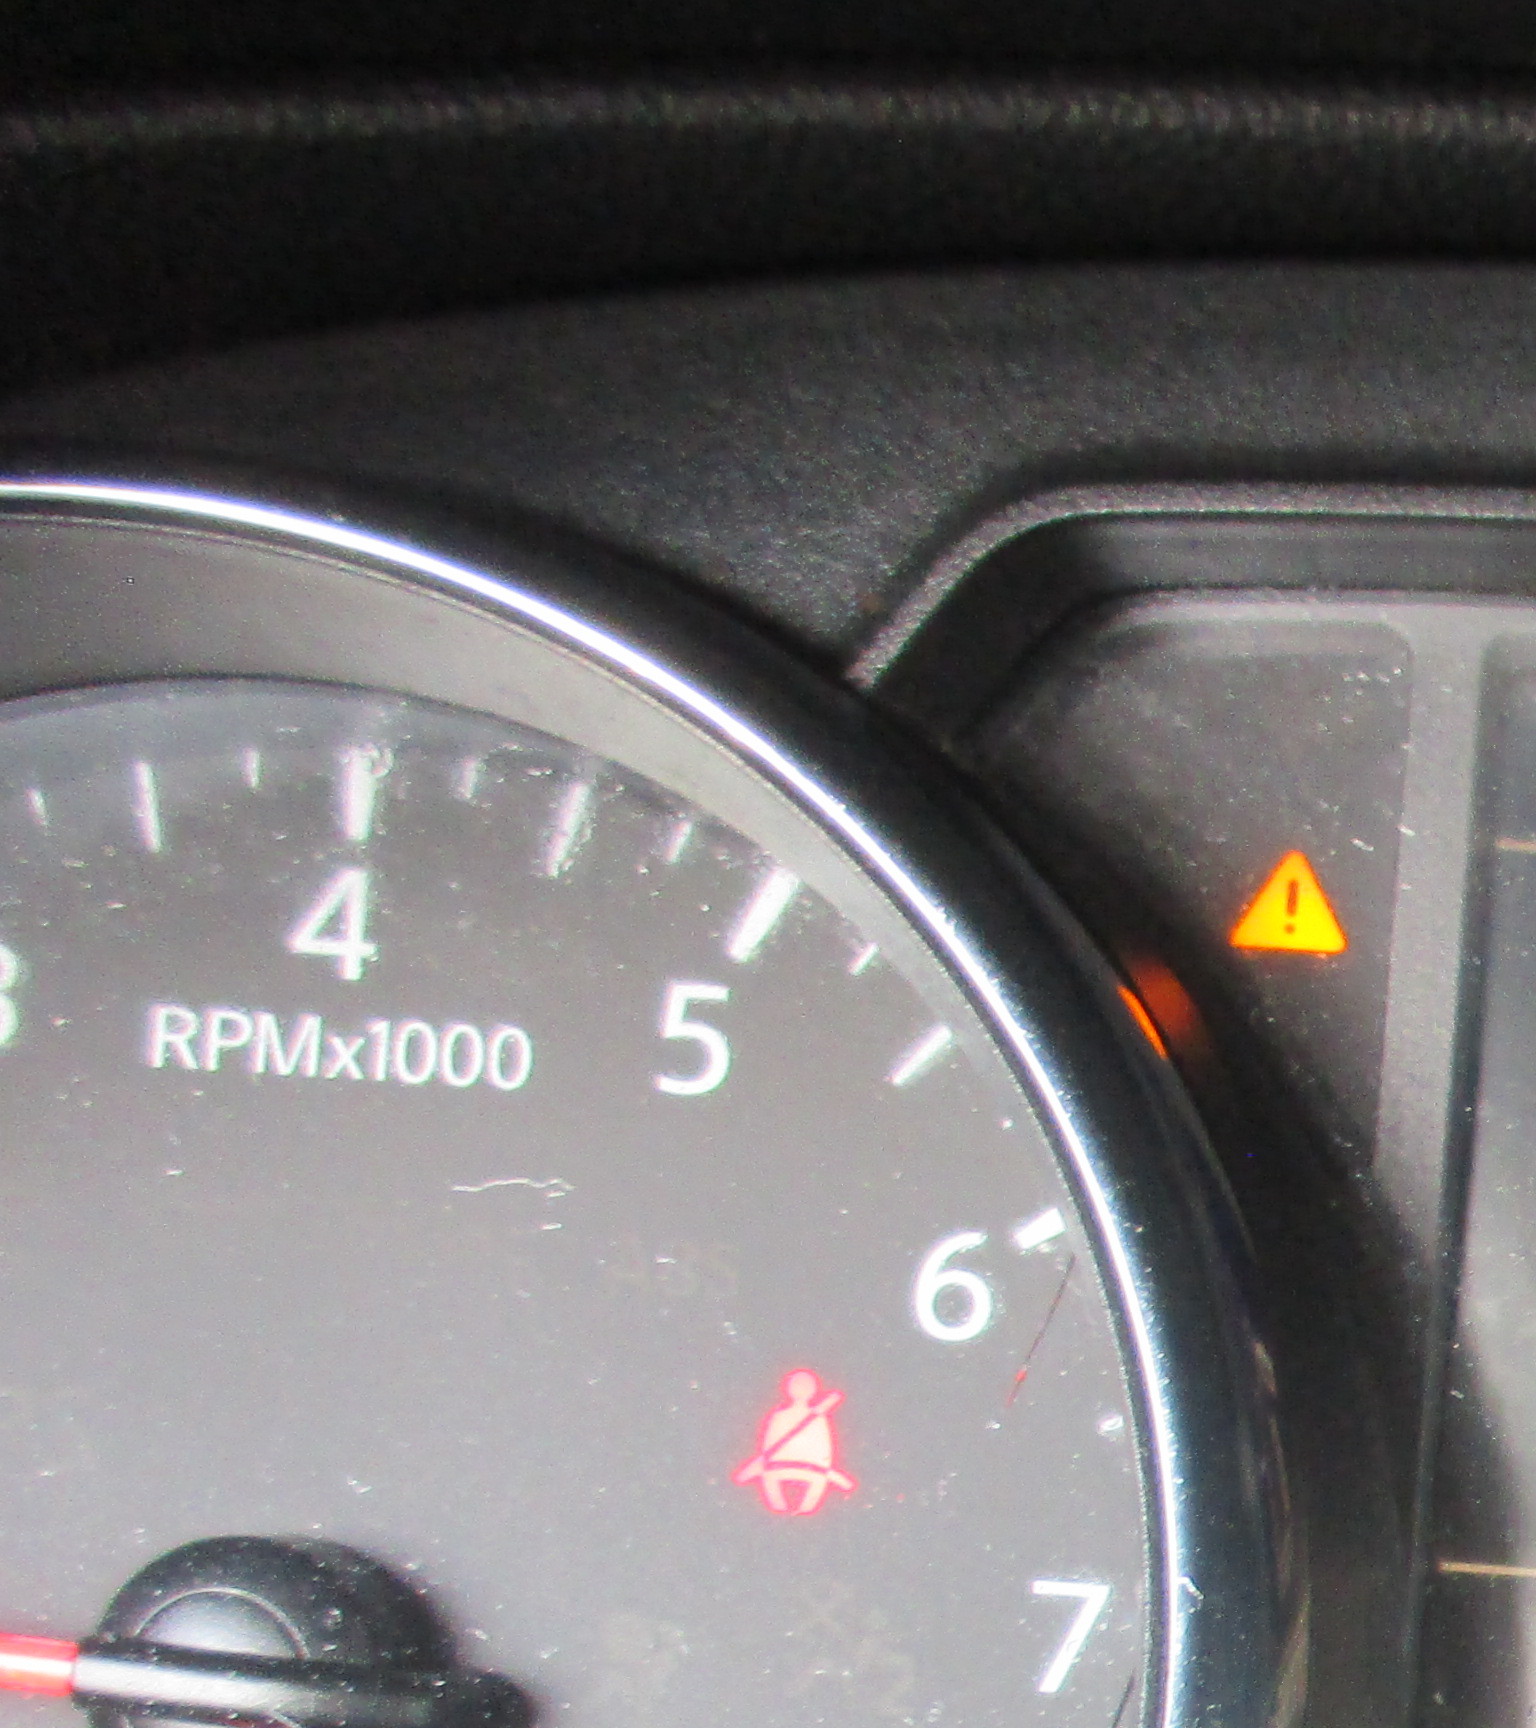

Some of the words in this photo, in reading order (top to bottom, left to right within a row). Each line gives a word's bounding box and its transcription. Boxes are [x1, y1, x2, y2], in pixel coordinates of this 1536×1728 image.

[290, 868, 375, 980] 4
[150, 1005, 531, 1091] RPMx1000
[657, 983, 728, 1095] 5
[914, 1232, 991, 1341] 6
[1033, 1580, 1109, 1693] 7
